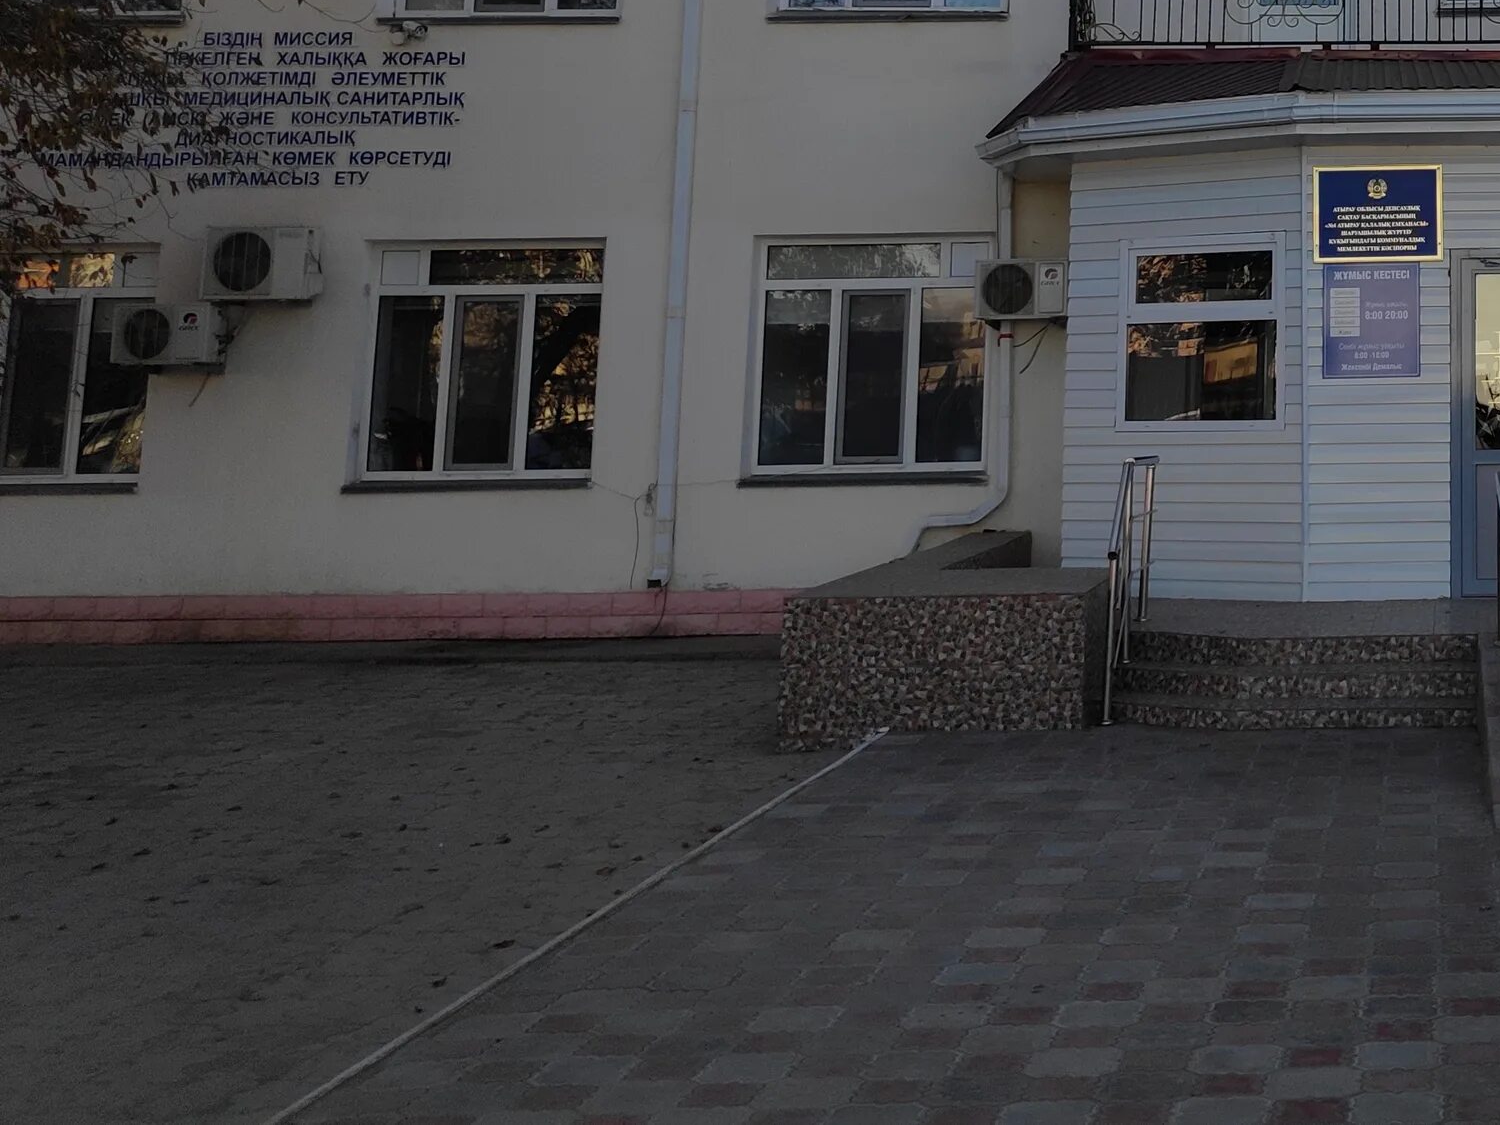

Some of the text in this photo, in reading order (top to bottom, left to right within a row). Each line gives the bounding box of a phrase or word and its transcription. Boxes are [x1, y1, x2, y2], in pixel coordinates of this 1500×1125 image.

[203, 31, 353, 49] БІЗДІҢ МИССИЯ
[276, 51, 367, 69] ХАЛЫҚҚА
[382, 51, 466, 66] ЖОҒАРЫ
[202, 71, 317, 88] ҚОЛЖЕТІМДІ
[331, 71, 446, 86] ӘЛЕУМЕТТІК
[183, 91, 331, 108] МЕДИЦИНАЛЫҚ
[336, 91, 465, 108] САНИТАРЛЫҚ
[219, 111, 274, 126] ЖӘНЕ
[291, 111, 461, 126] КОНСУЛЬТАТИВТІК-
[272, 151, 335, 166] КӨМЕК
[349, 151, 451, 168] КӨРСЕТУДІ
[334, 171, 369, 186] ЕТУ
[1374, 270, 1410, 280] КЕСТЕСІ
